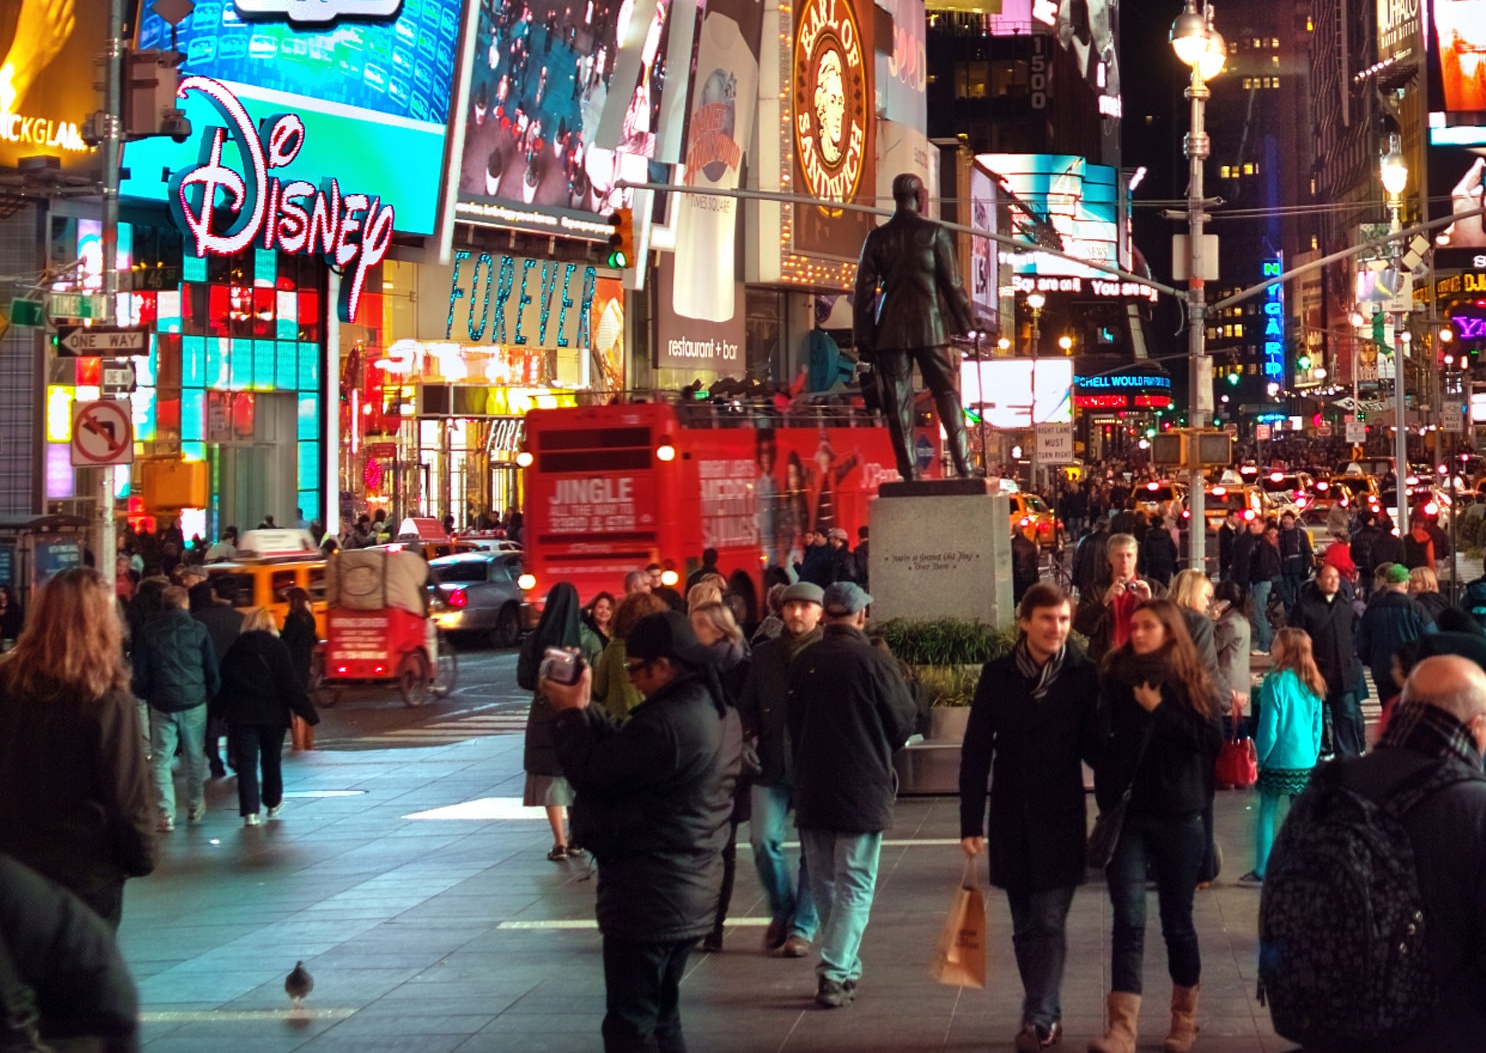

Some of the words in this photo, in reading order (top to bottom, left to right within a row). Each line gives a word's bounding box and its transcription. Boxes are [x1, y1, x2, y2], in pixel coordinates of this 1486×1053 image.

[841, 18, 860, 68] OF
[799, 111, 863, 203] SANDWICH
[446, 250, 597, 348] FOREVER
[70, 335, 97, 348] ONE
[109, 335, 138, 347] WAY
[668, 337, 714, 360] restaurant
[723, 339, 738, 360] bar
[1038, 451, 1054, 459] TURN
[1044, 438, 1064, 447] MUST
[550, 477, 634, 505] JINGLE
